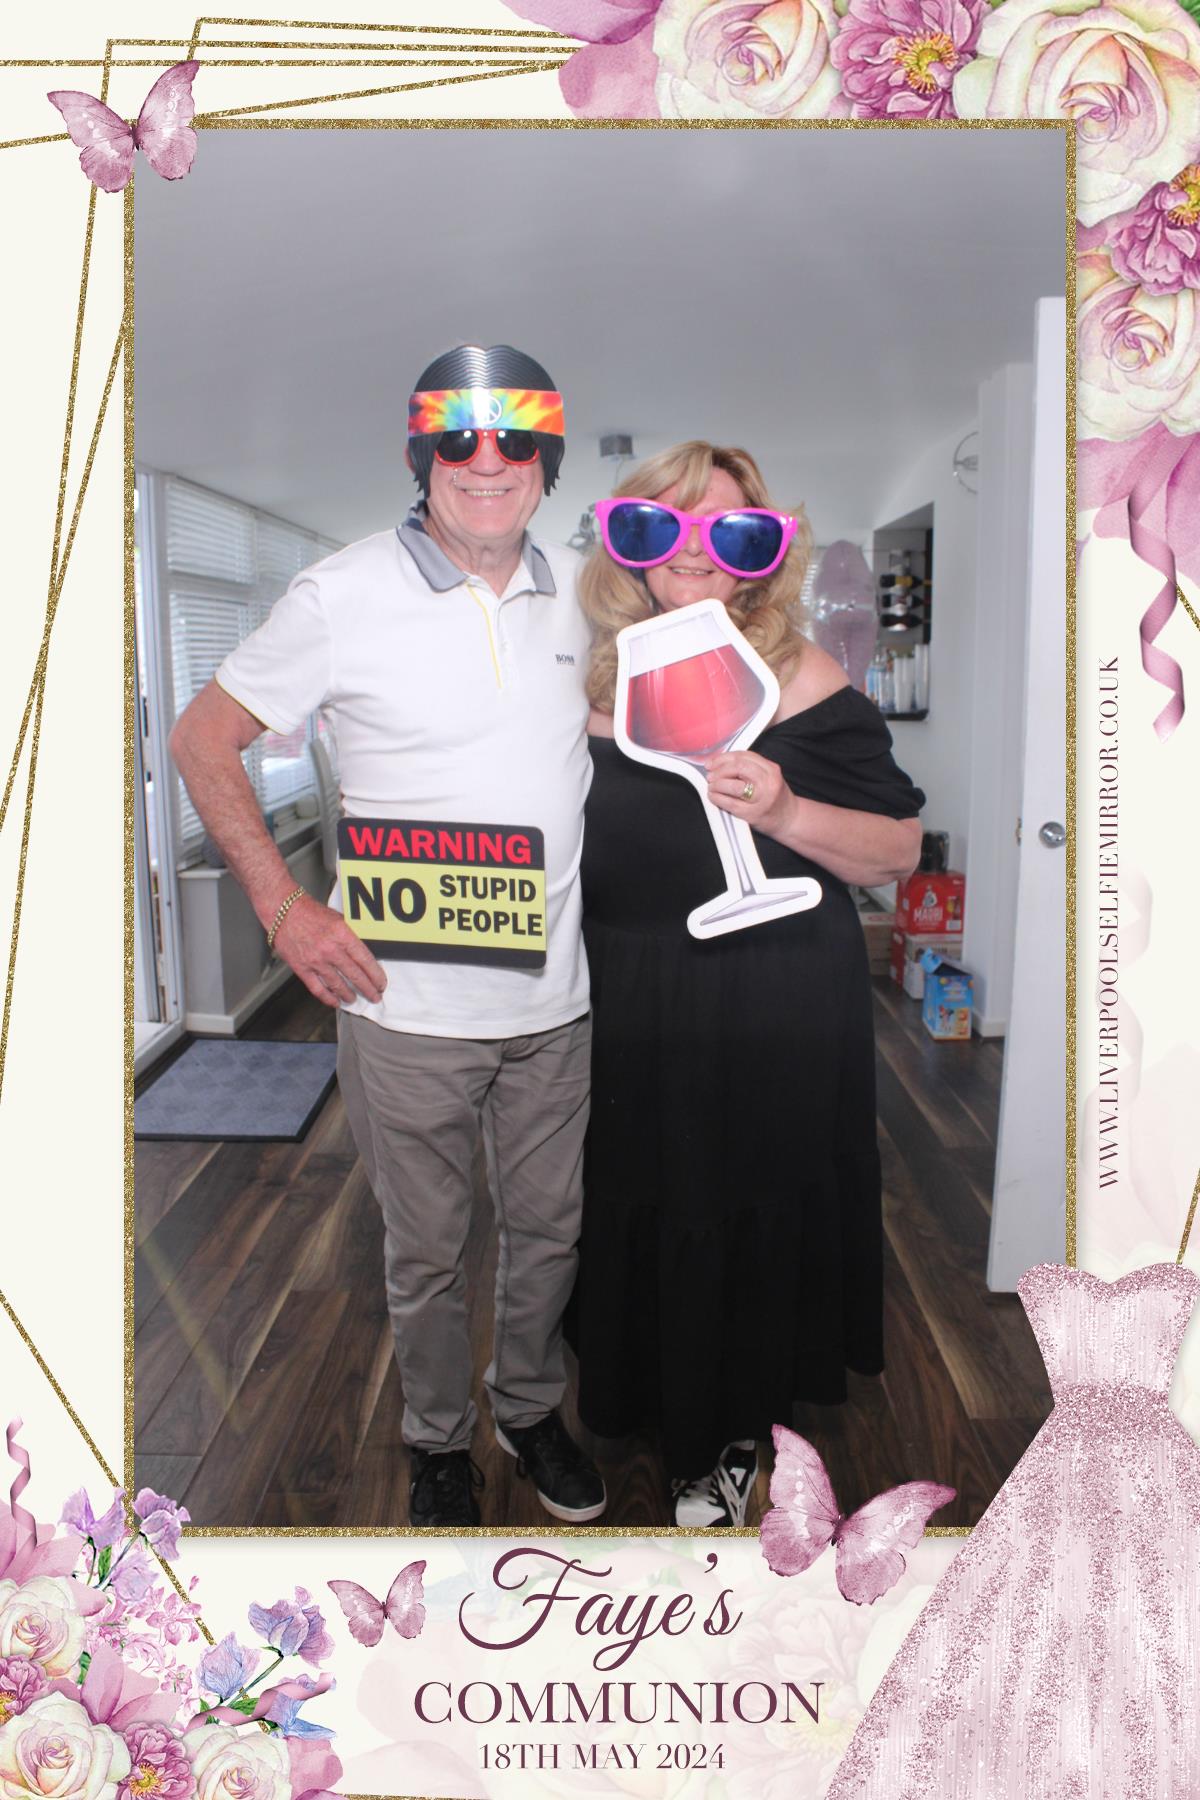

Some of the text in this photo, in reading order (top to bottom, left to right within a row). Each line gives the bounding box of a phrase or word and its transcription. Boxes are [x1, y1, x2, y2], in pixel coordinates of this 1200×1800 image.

[347, 825, 532, 865] WARNING
[347, 875, 427, 924] NO
[439, 874, 537, 902] STUPID
[438, 907, 543, 937] PEOPLE
